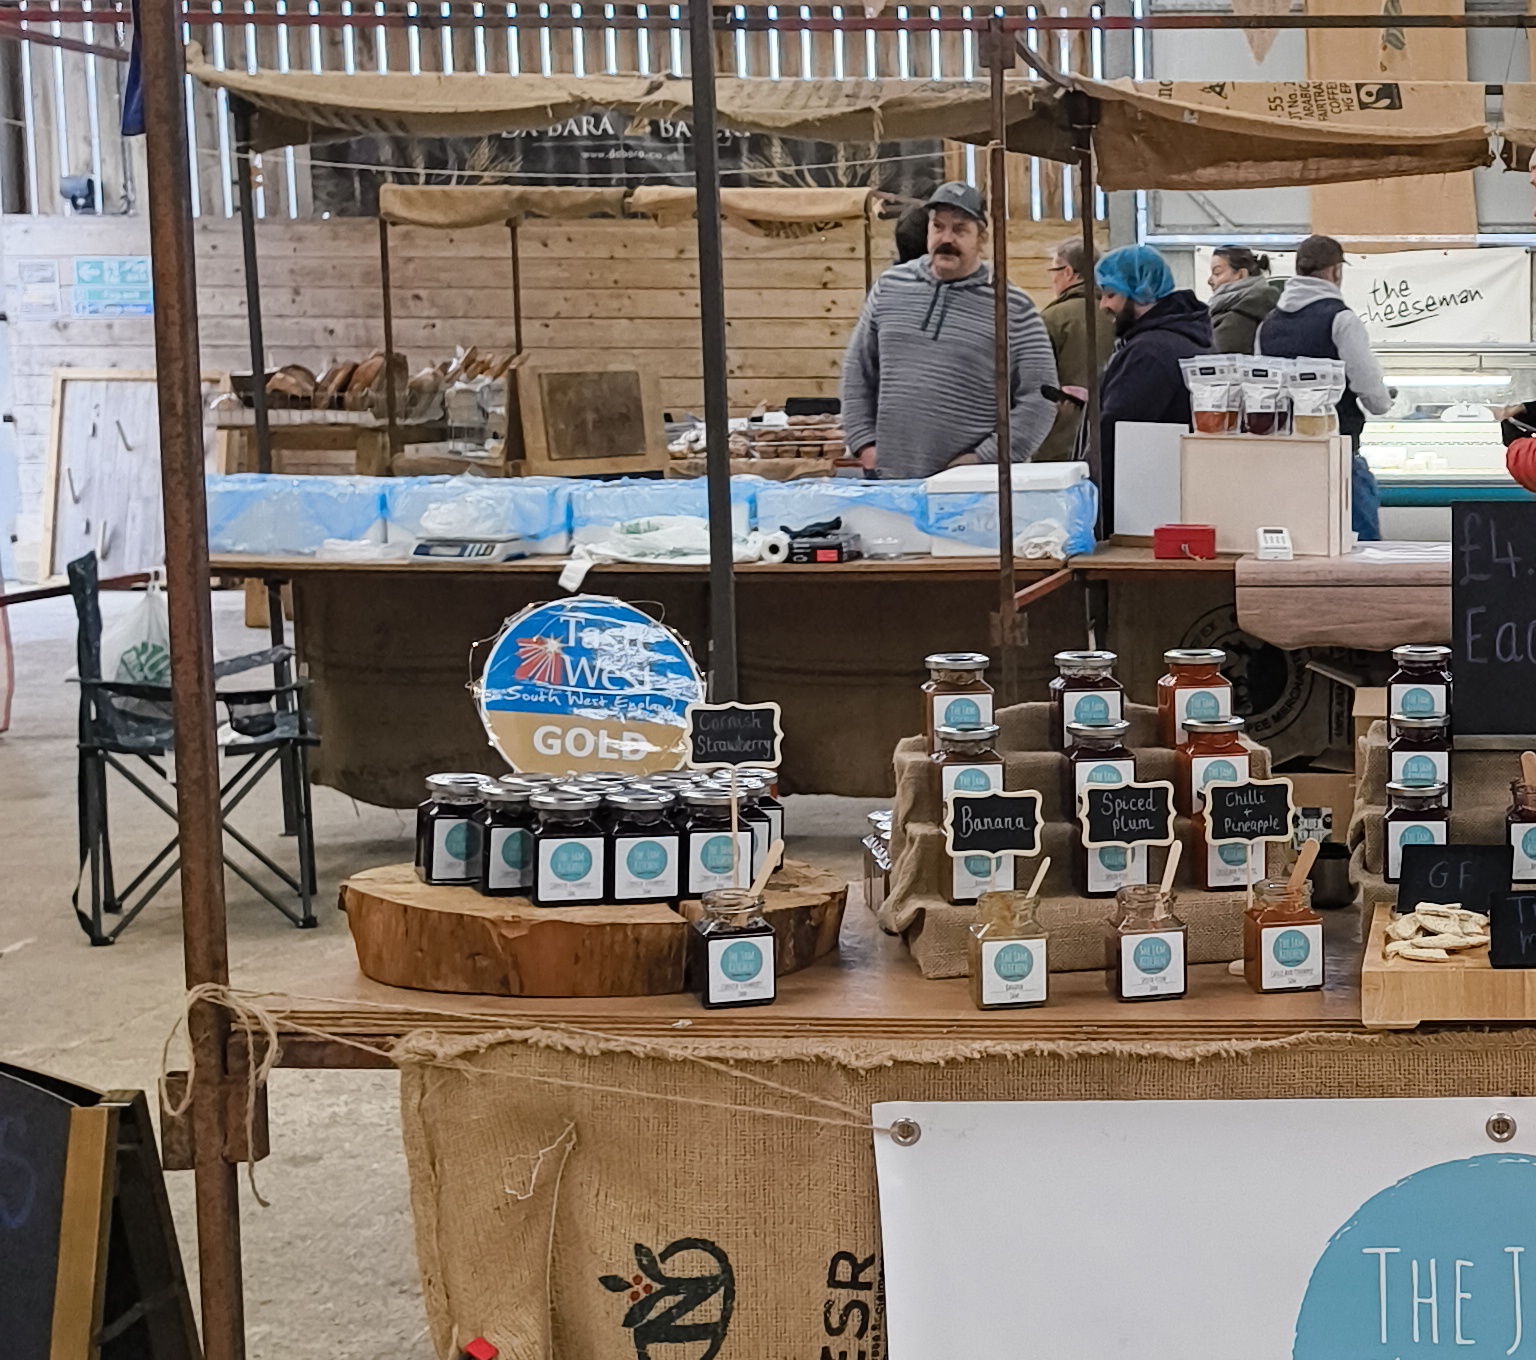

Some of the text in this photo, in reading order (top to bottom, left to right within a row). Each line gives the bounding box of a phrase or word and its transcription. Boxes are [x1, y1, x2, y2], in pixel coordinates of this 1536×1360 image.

[1369, 278, 1411, 306] the
[1358, 289, 1483, 325] cheeseman
[503, 688, 561, 706] South
[567, 691, 605, 707] West
[533, 725, 649, 762] GOLD
[697, 735, 771, 757] Strawberry
[1101, 790, 1157, 816] Spiced
[1225, 790, 1267, 807] Chilli
[959, 805, 1030, 838] Banana
[1224, 817, 1281, 834] Pineapple
[1362, 1246, 1476, 1344] THE
